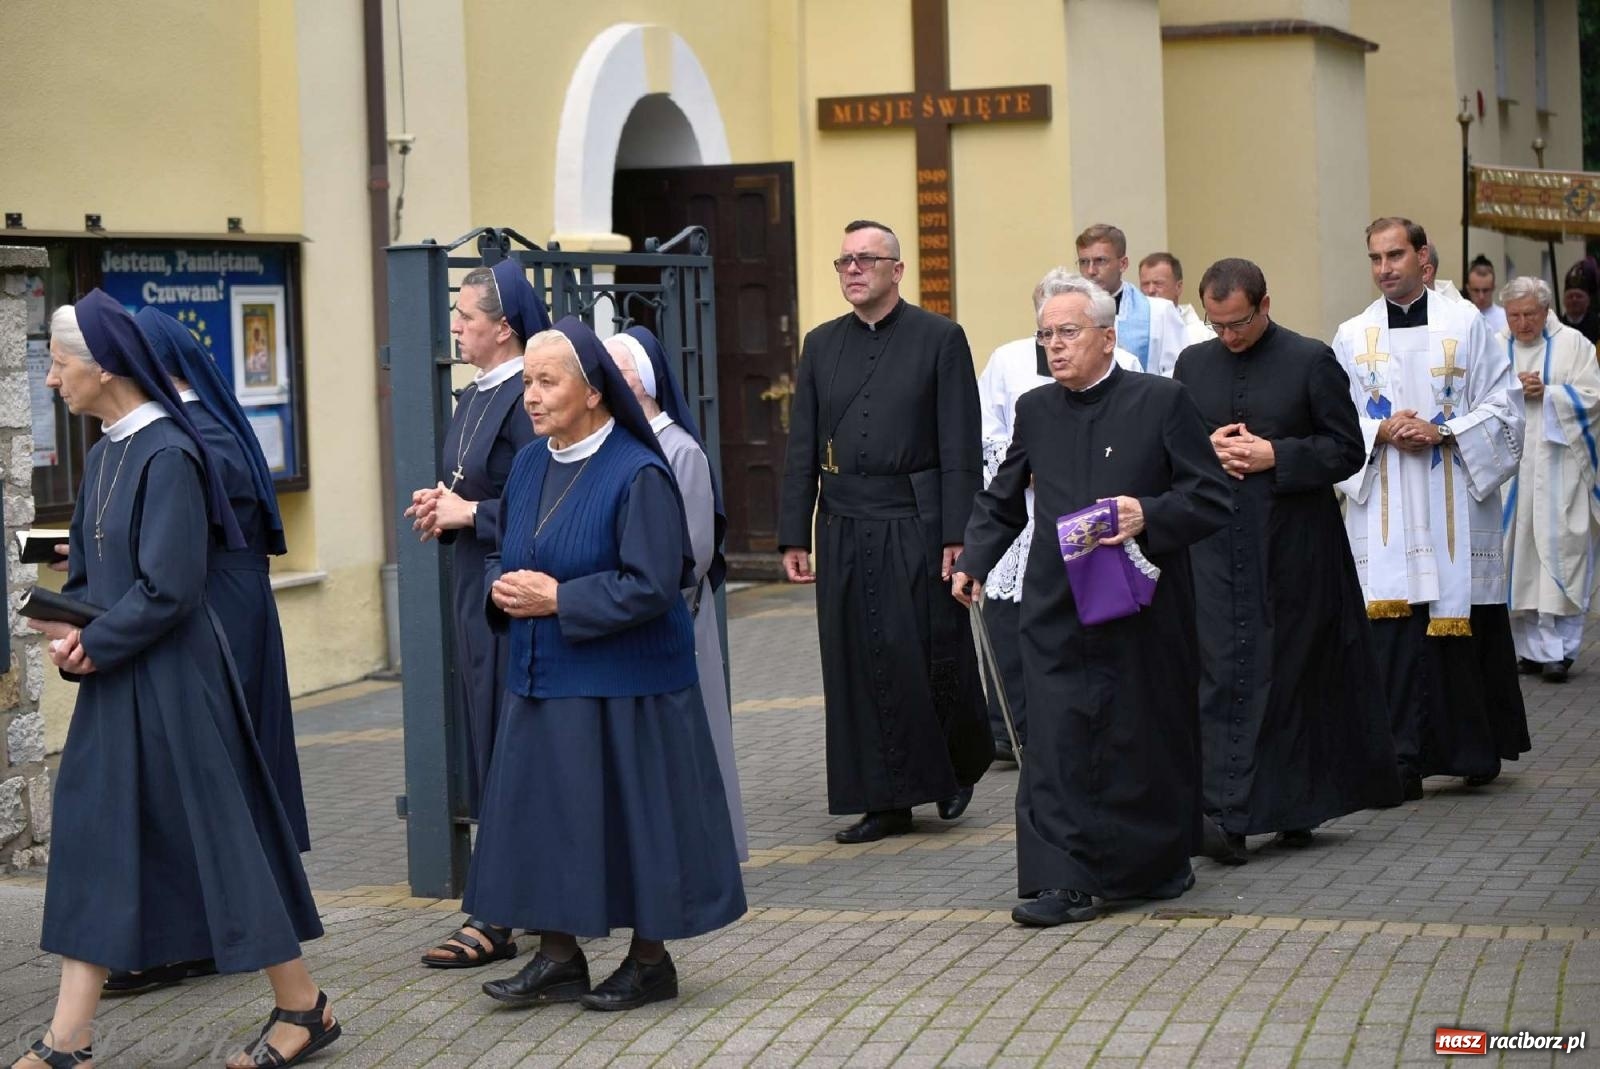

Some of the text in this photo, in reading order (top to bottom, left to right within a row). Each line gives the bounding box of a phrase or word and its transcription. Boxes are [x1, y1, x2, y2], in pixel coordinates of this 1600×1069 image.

[832, 92, 1031, 125] MISJE ŚWIĘTE
[919, 169, 947, 184] 1949
[920, 212, 947, 227] 1971
[921, 235, 948, 249] 1982
[101, 250, 264, 276] Jestem, Pamiętam,
[922, 256, 949, 270] 1992
[142, 279, 224, 304] Czuwam!
[922, 277, 949, 292] 2002
